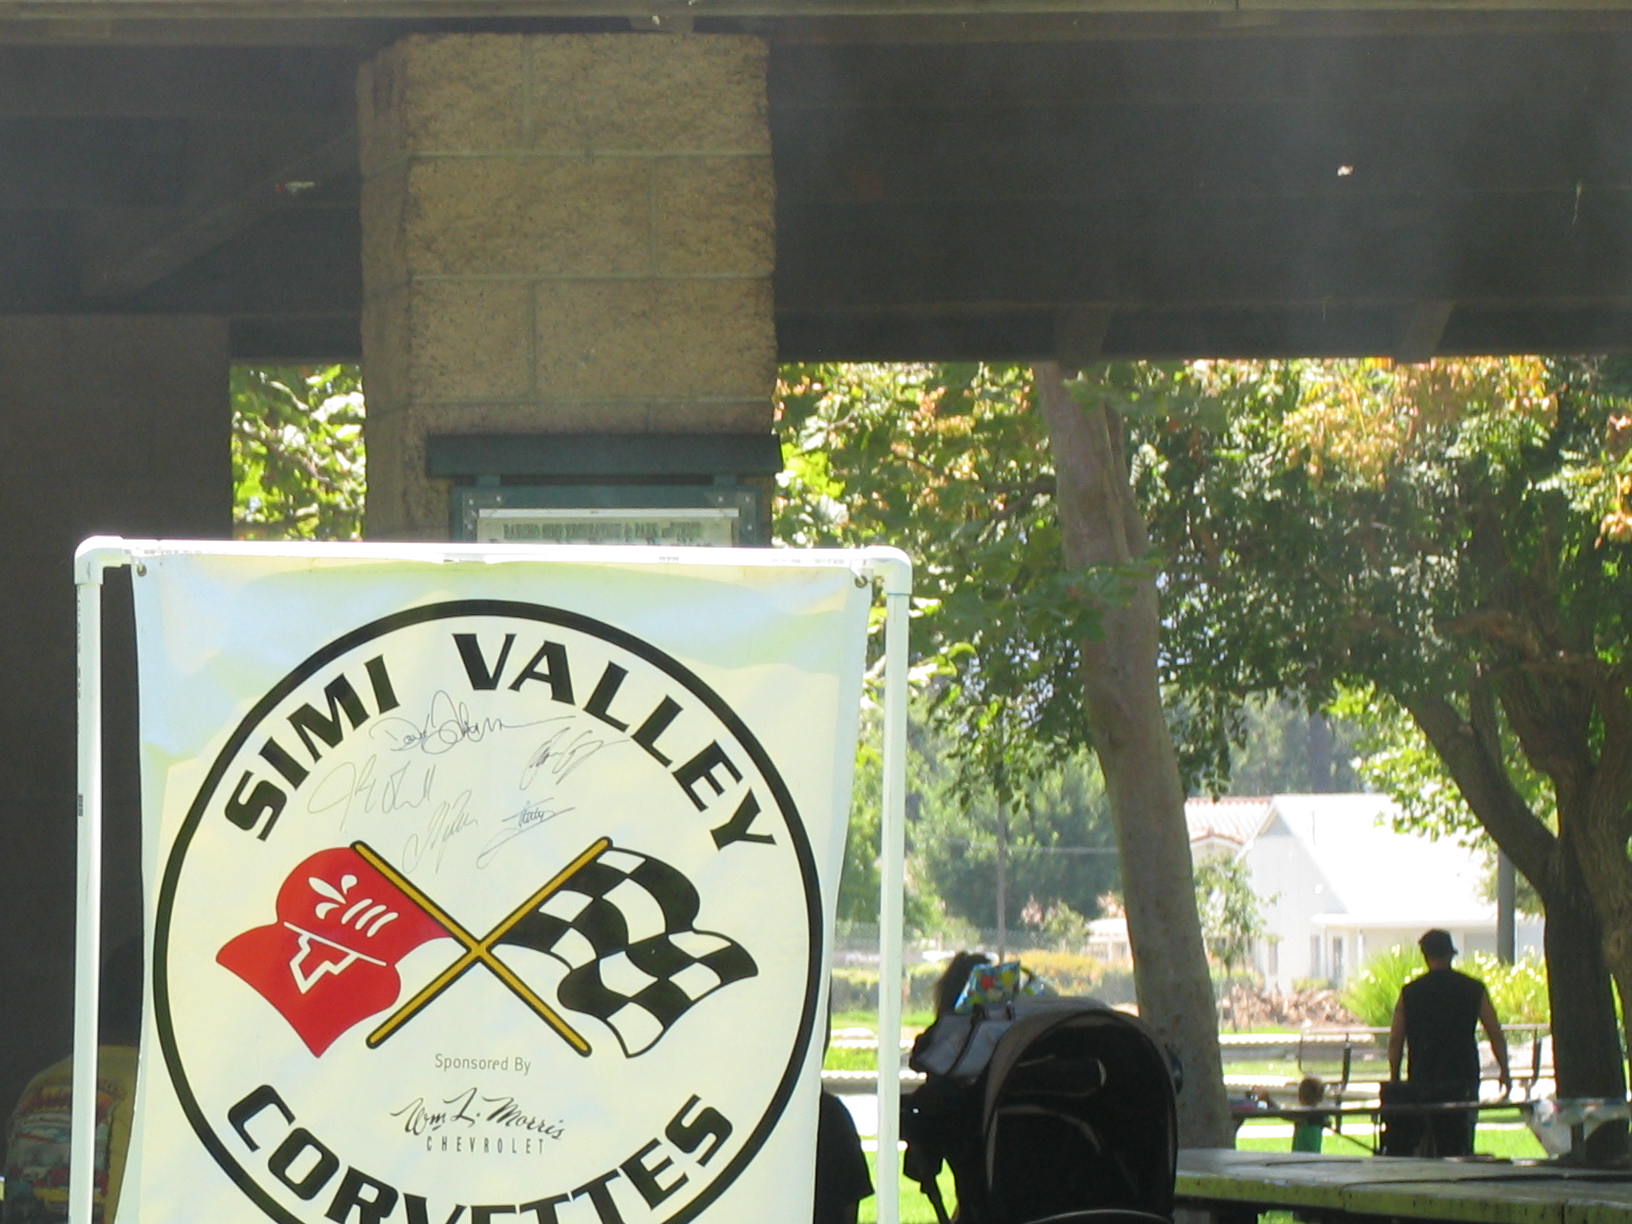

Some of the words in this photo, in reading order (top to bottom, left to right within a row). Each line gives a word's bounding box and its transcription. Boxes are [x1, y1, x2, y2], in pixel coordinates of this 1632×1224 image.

[224, 654, 401, 842] SIMI
[452, 633, 777, 851] VALLEY
[434, 1053, 509, 1072] Sponsored
[514, 1056, 532, 1077] By
[482, 1096, 566, 1141] Morris
[425, 1135, 545, 1155] CHEVROLET
